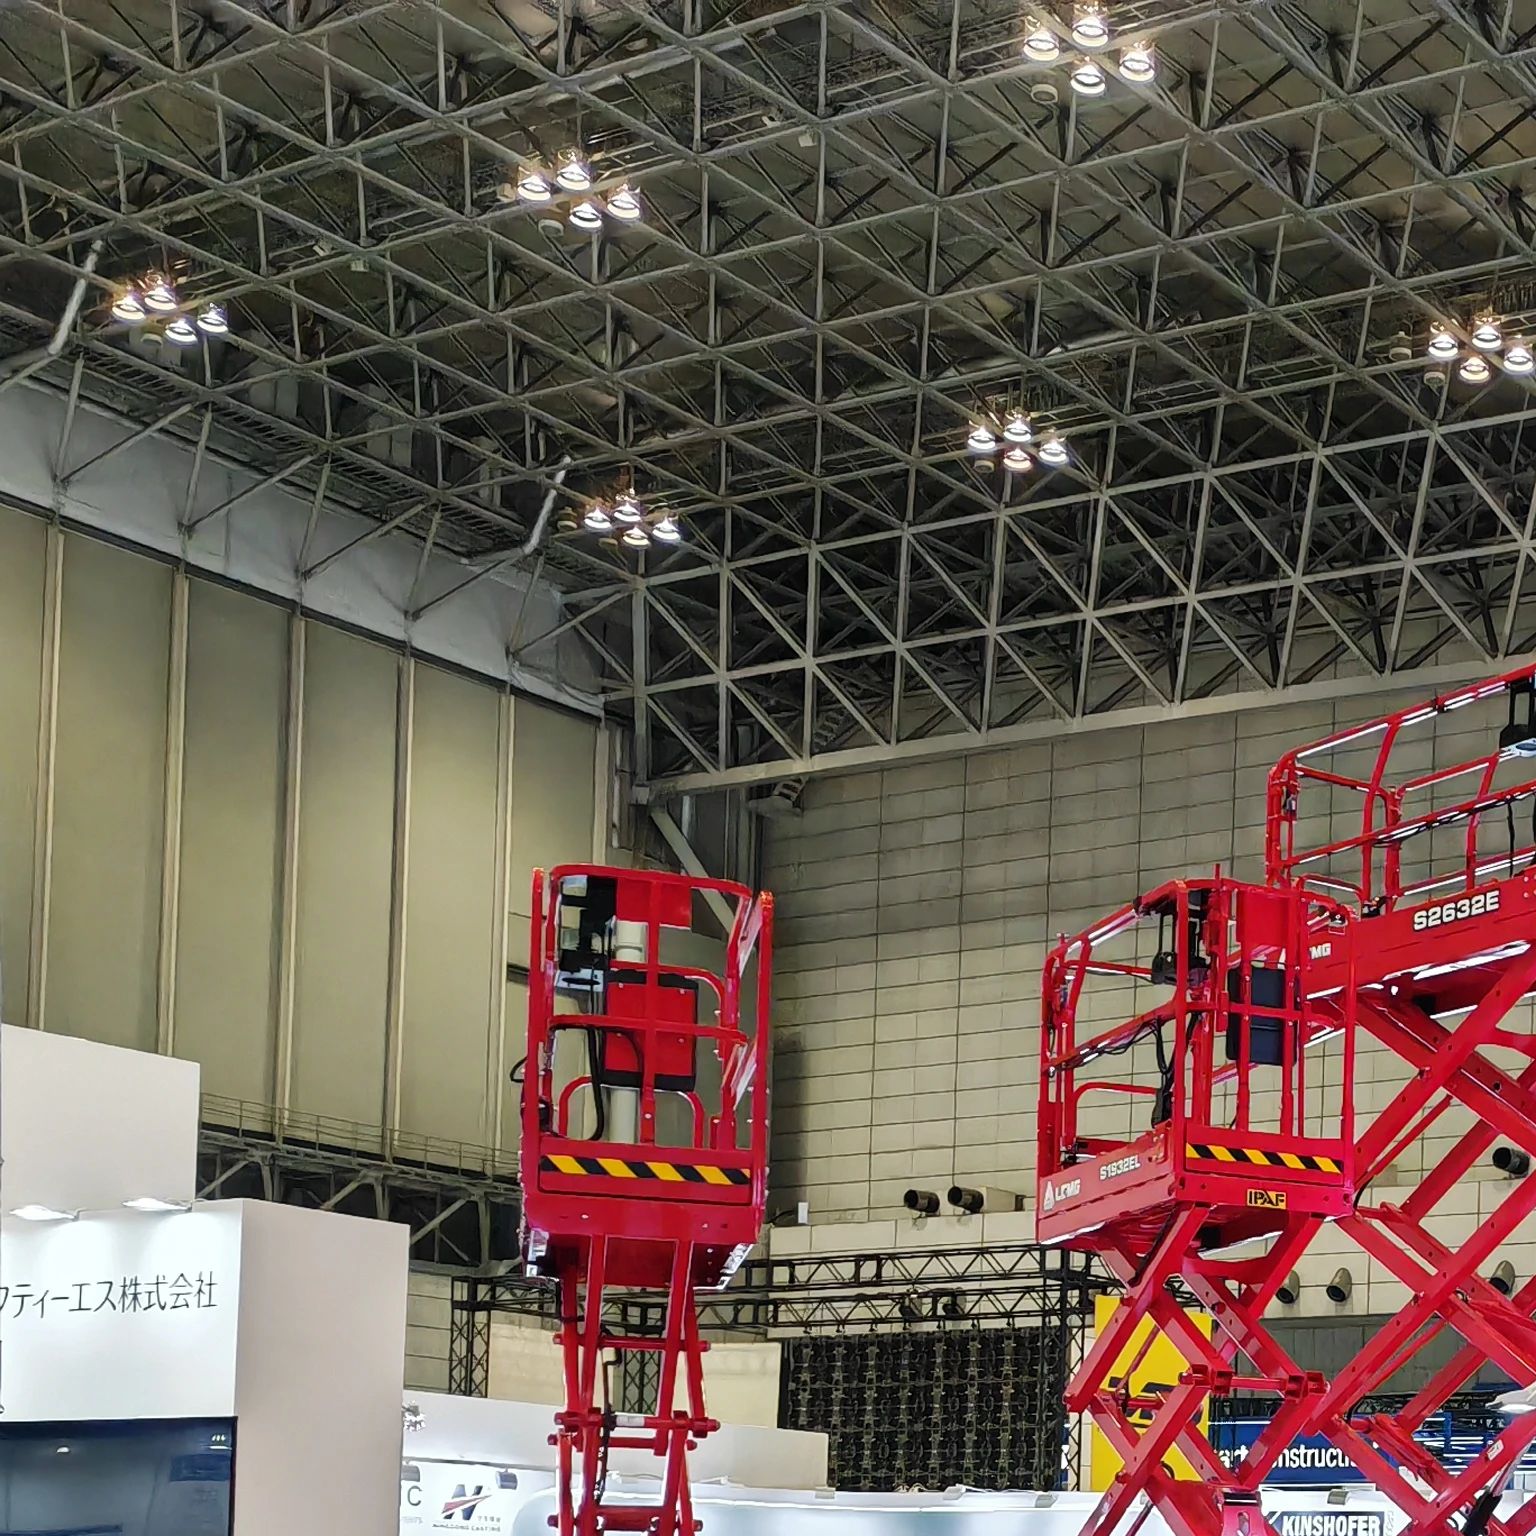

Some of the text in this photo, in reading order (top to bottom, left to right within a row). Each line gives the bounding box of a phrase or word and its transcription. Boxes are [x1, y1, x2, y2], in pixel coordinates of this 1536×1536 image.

[1412, 889, 1500, 932] S2632E
[1309, 942, 1332, 960] MG
[1099, 1154, 1141, 1182] S1932EL
[1247, 1190, 1285, 1207] IPAF
[1271, 1444, 1358, 1469] nstructi
